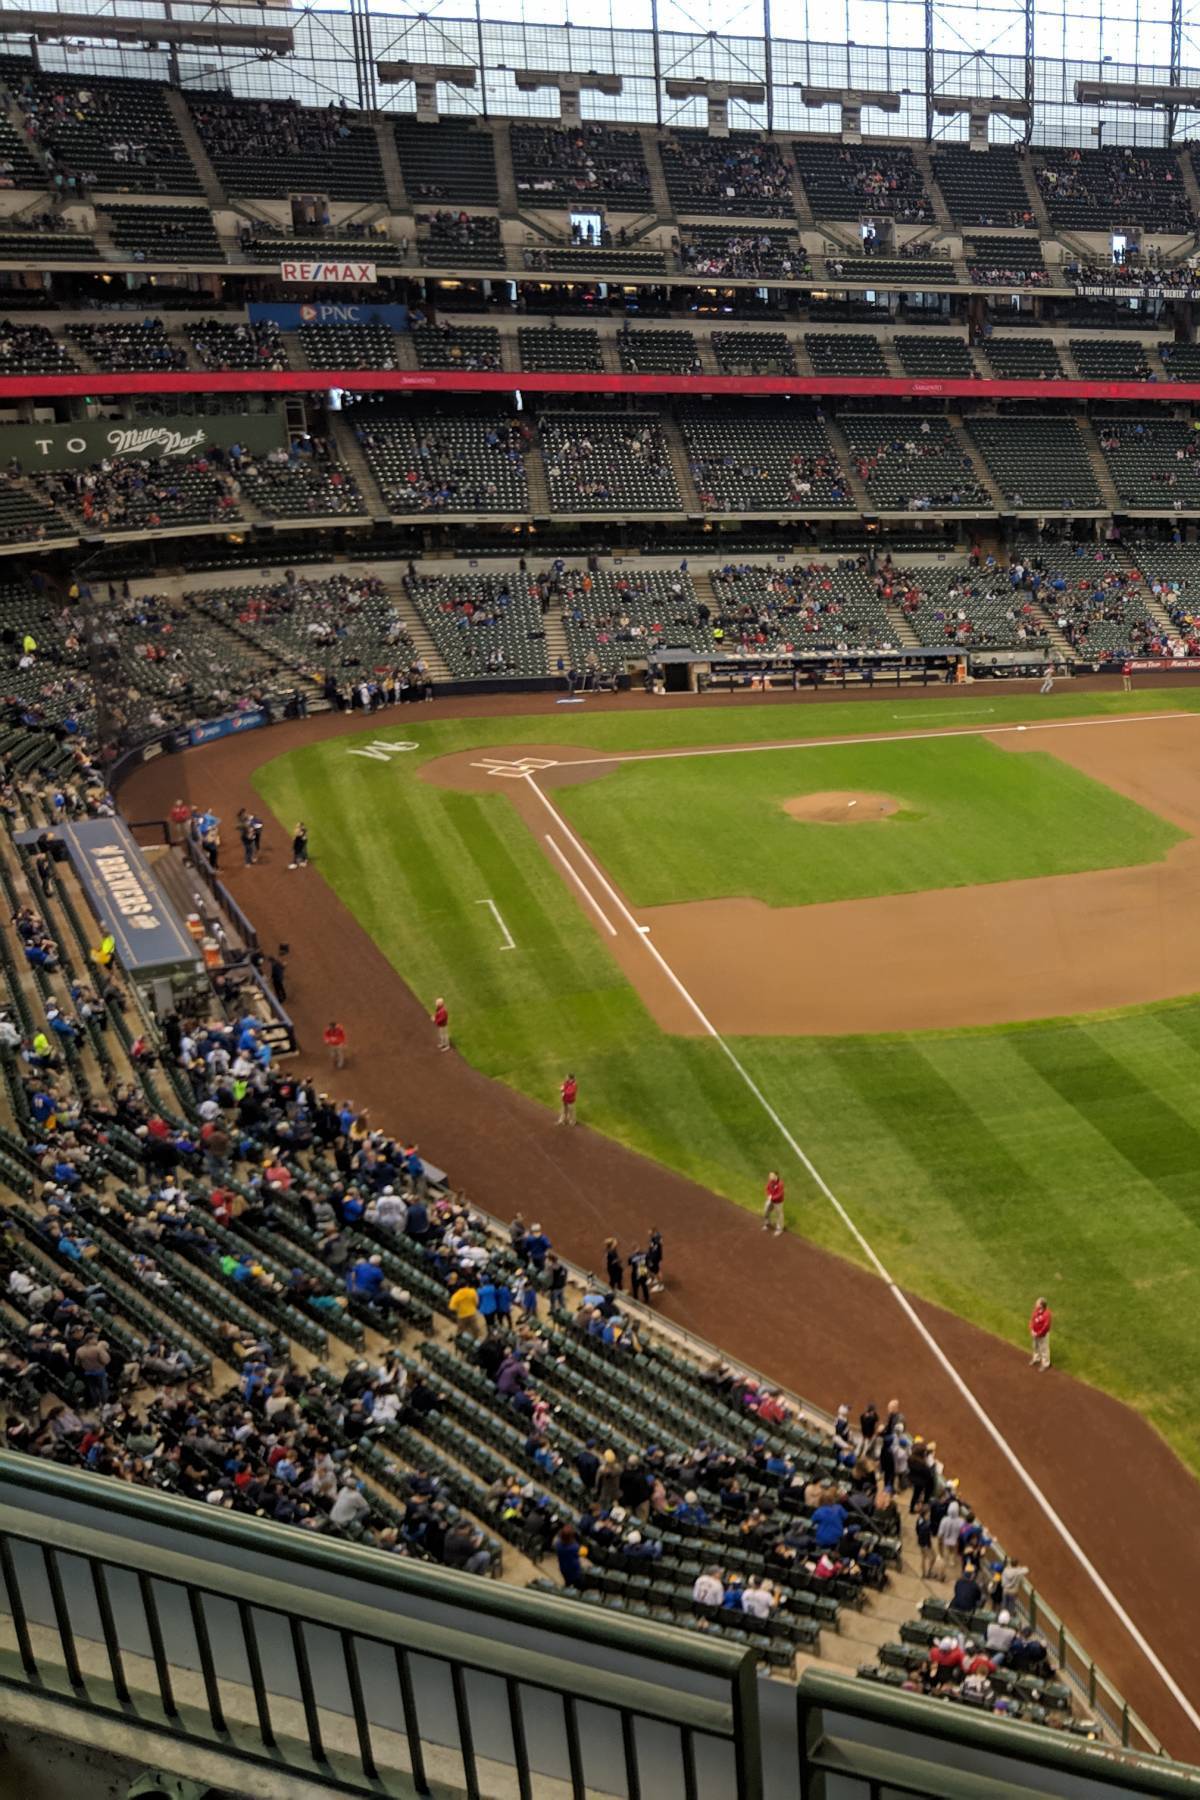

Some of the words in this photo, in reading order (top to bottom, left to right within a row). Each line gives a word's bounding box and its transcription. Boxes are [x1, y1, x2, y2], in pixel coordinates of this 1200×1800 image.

[283, 264, 371, 281] RE/MAX
[320, 306, 360, 321] PNC
[107, 427, 168, 456] Miller
[157, 429, 208, 458] Park
[96, 856, 152, 915] BREWERS
